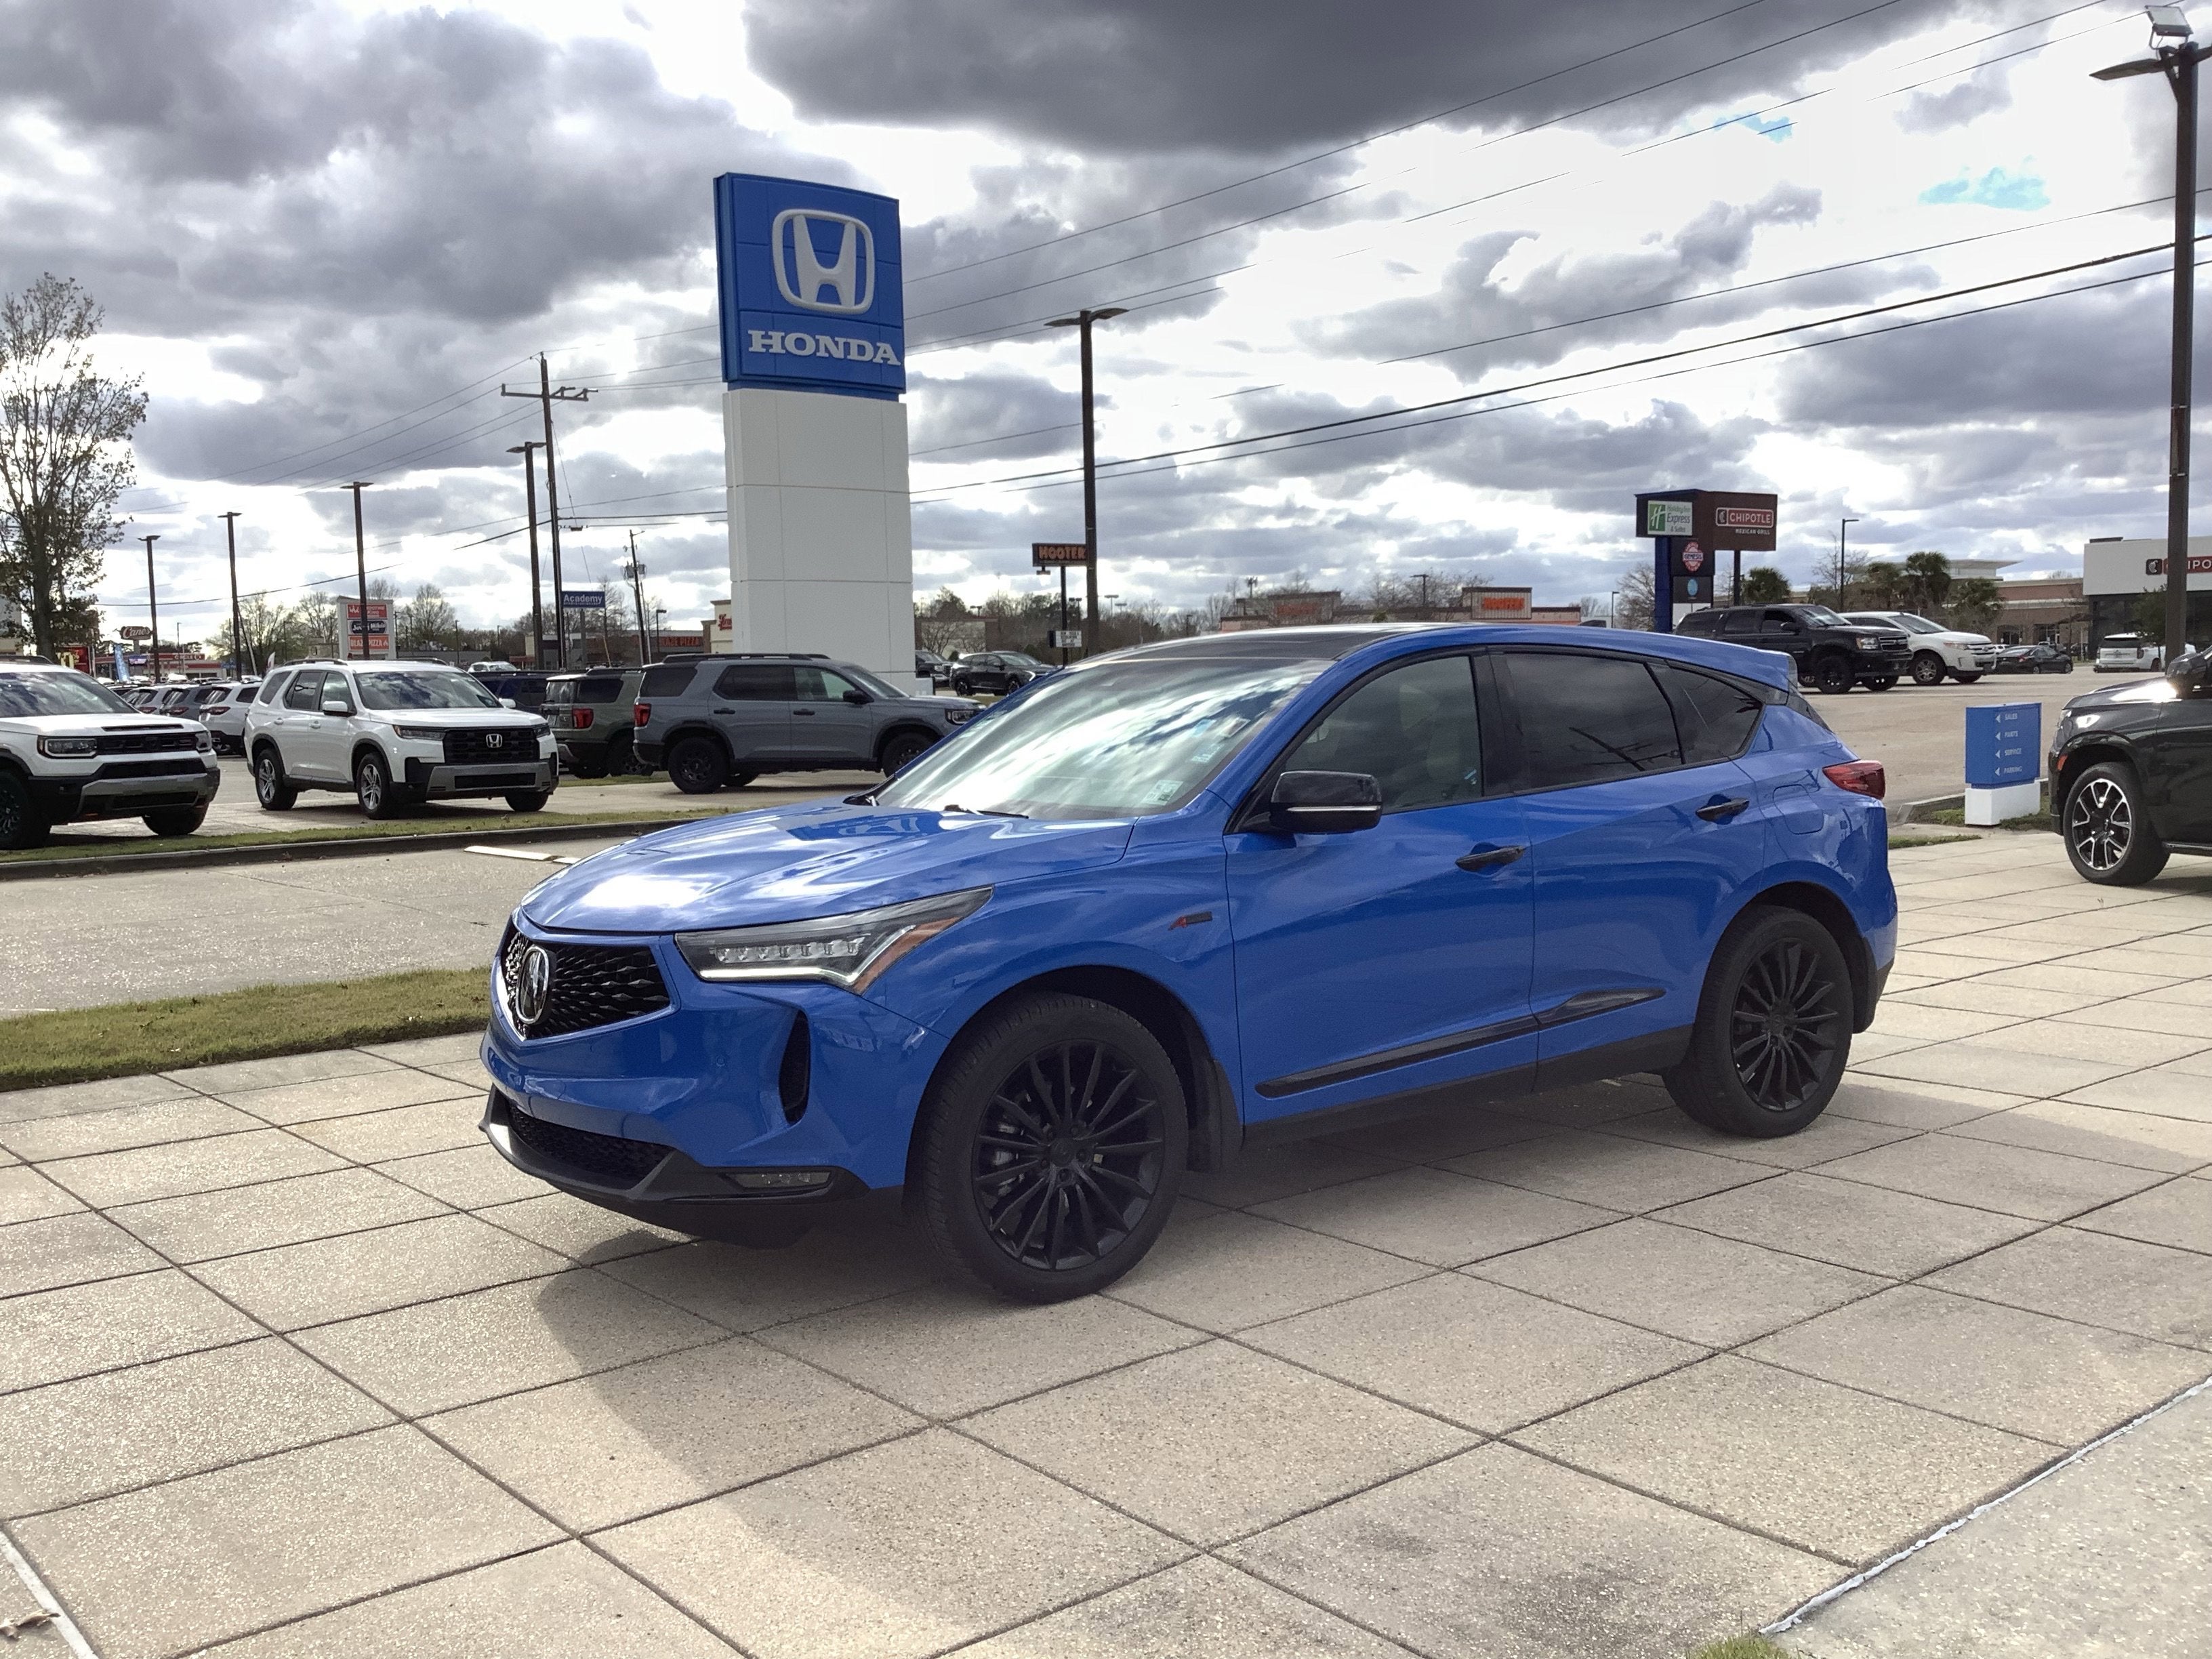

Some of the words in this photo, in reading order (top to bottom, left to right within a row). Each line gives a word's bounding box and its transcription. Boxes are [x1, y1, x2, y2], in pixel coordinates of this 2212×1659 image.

[747, 329, 901, 366] HONDA
[1666, 513, 1690, 525] Express
[1729, 512, 1771, 523] CHIPOTLE
[1039, 546, 1085, 559] HOOTER
[563, 594, 602, 605] Academy
[2003, 766, 2023, 774] PARKING
